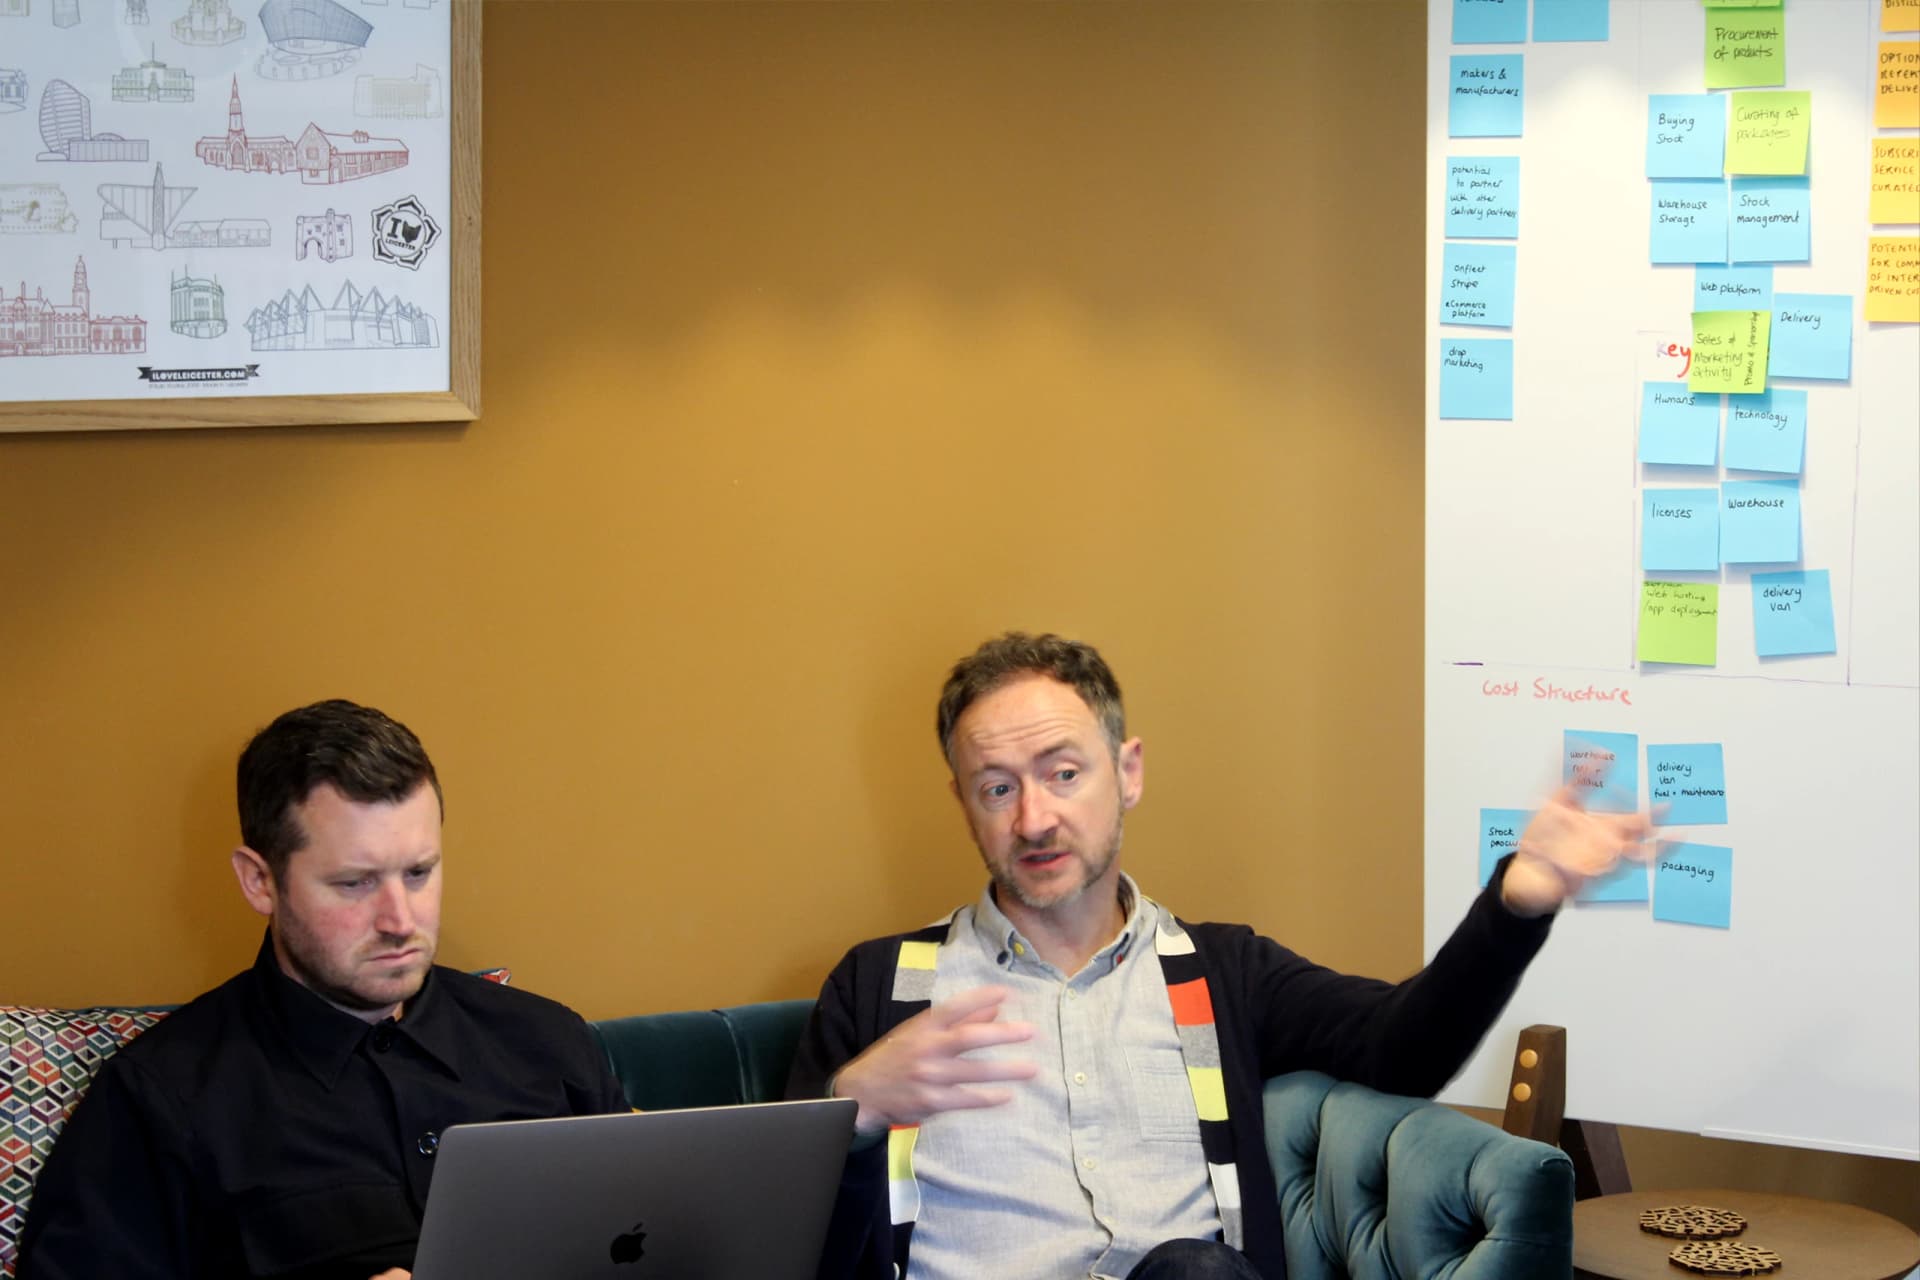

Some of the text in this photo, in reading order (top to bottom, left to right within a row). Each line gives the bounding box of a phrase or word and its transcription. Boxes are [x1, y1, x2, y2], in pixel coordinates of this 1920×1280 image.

[1714, 26, 1780, 42] Procurement
[1713, 45, 1729, 61] of
[1455, 85, 1519, 97] manufacturers
[1658, 112, 1695, 131] Buying
[1658, 199, 1708, 210] Warehouse
[1738, 194, 1770, 207] Stock
[1451, 206, 1483, 221] delivery
[1658, 213, 1696, 228] Storage
[1871, 243, 1920, 253] POTENTI
[1720, 283, 1761, 296] platform
[1451, 308, 1486, 319] platform
[1780, 310, 1821, 330] Delivery
[152, 370, 246, 380] ILOVELEICESTER.COM
[1654, 393, 1695, 406] Humans
[1735, 406, 1788, 430] technology
[1652, 503, 1692, 519] licenses
[1763, 584, 1803, 603] delivery
[1482, 676, 1632, 706] Cost Structure
[1656, 761, 1692, 777] delivery
[1488, 826, 1515, 837] Stock
[1490, 839, 1521, 849] procu
[1661, 860, 1716, 884] packaging
